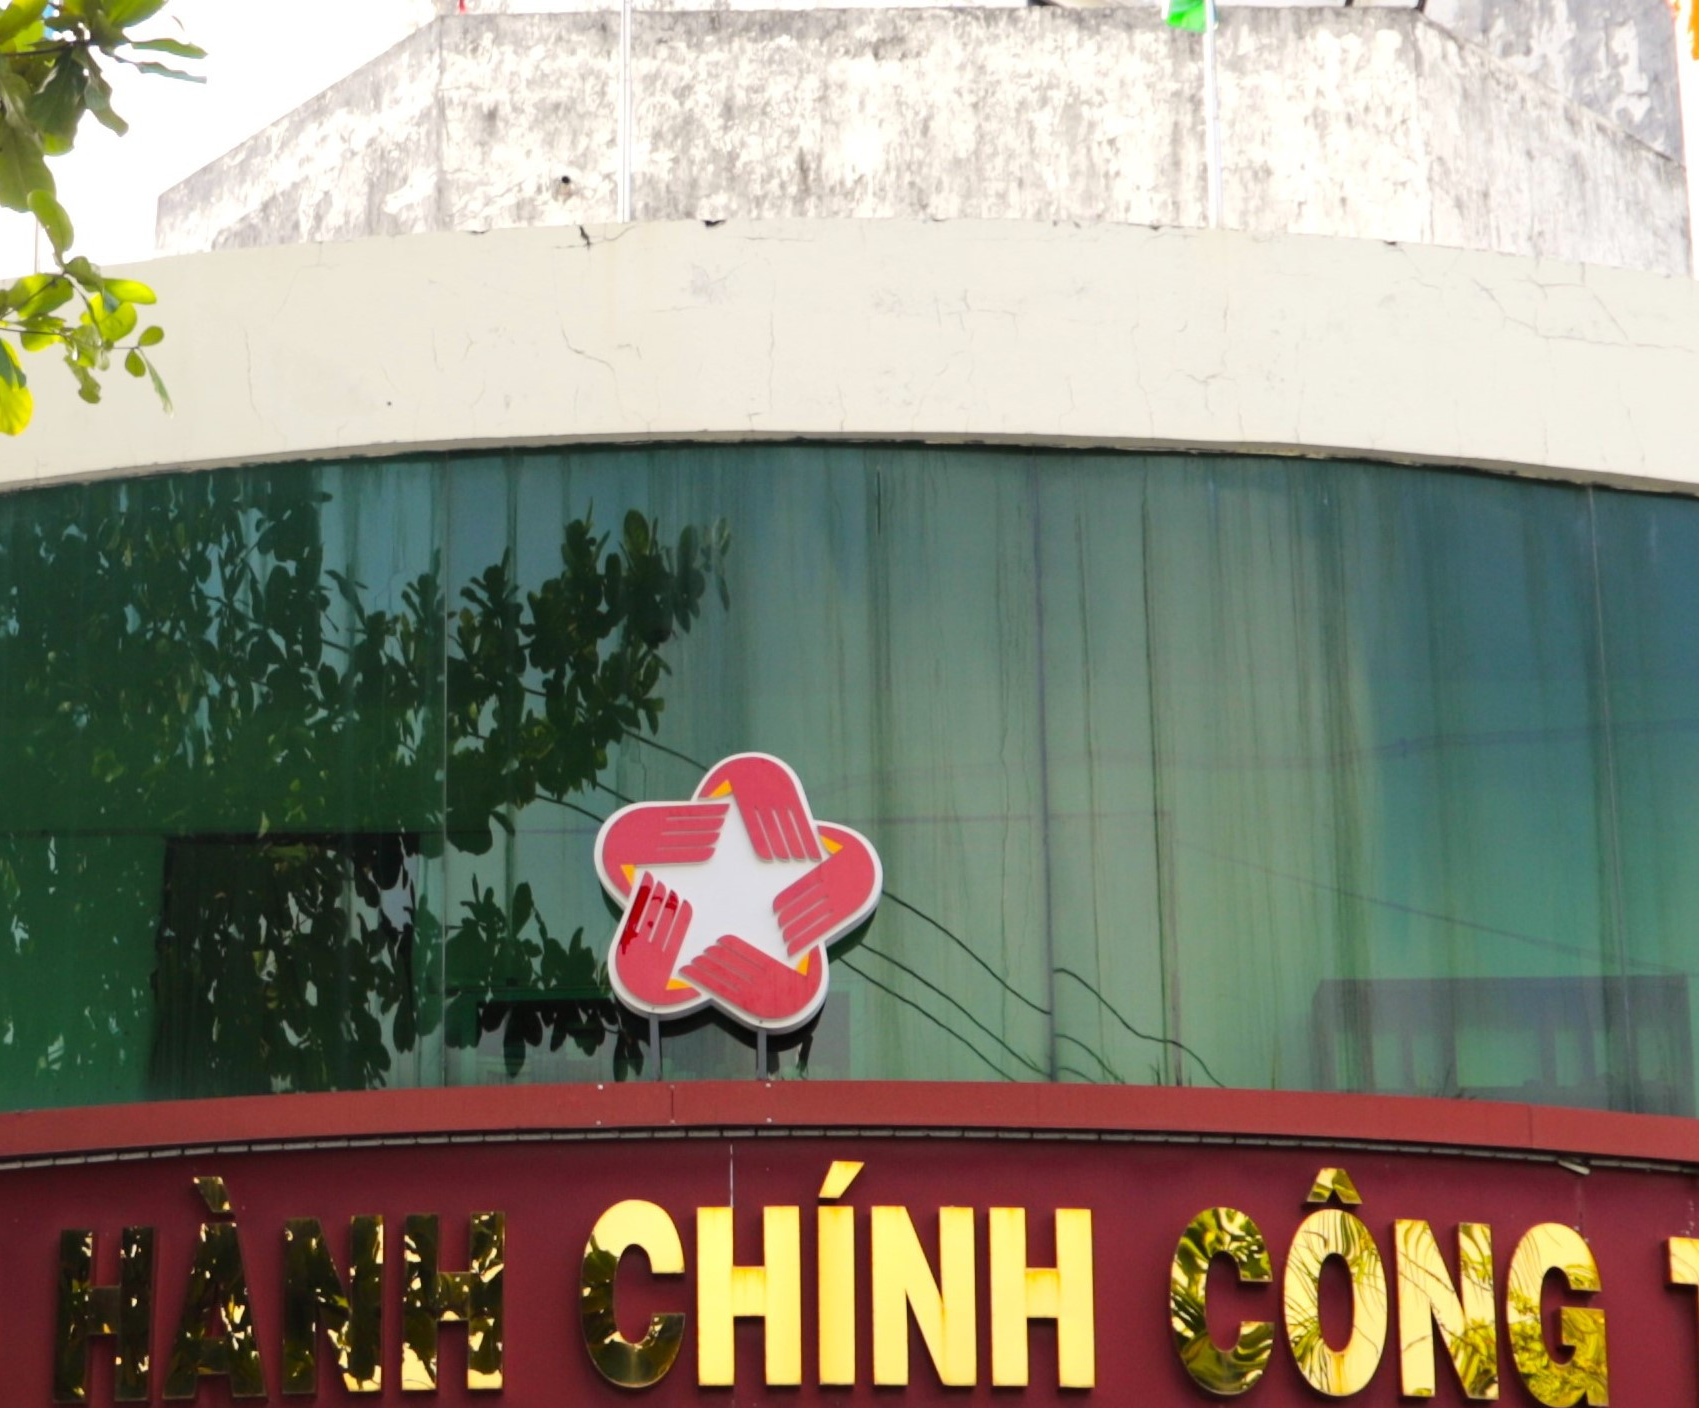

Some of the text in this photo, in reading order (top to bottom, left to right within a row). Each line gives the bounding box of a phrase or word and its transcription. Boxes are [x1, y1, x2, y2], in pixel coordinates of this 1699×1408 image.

[55, 1176, 505, 1401] HÀNH
[580, 1161, 1095, 1389] CHÍNH
[1169, 1167, 1609, 1408] CÔNG
